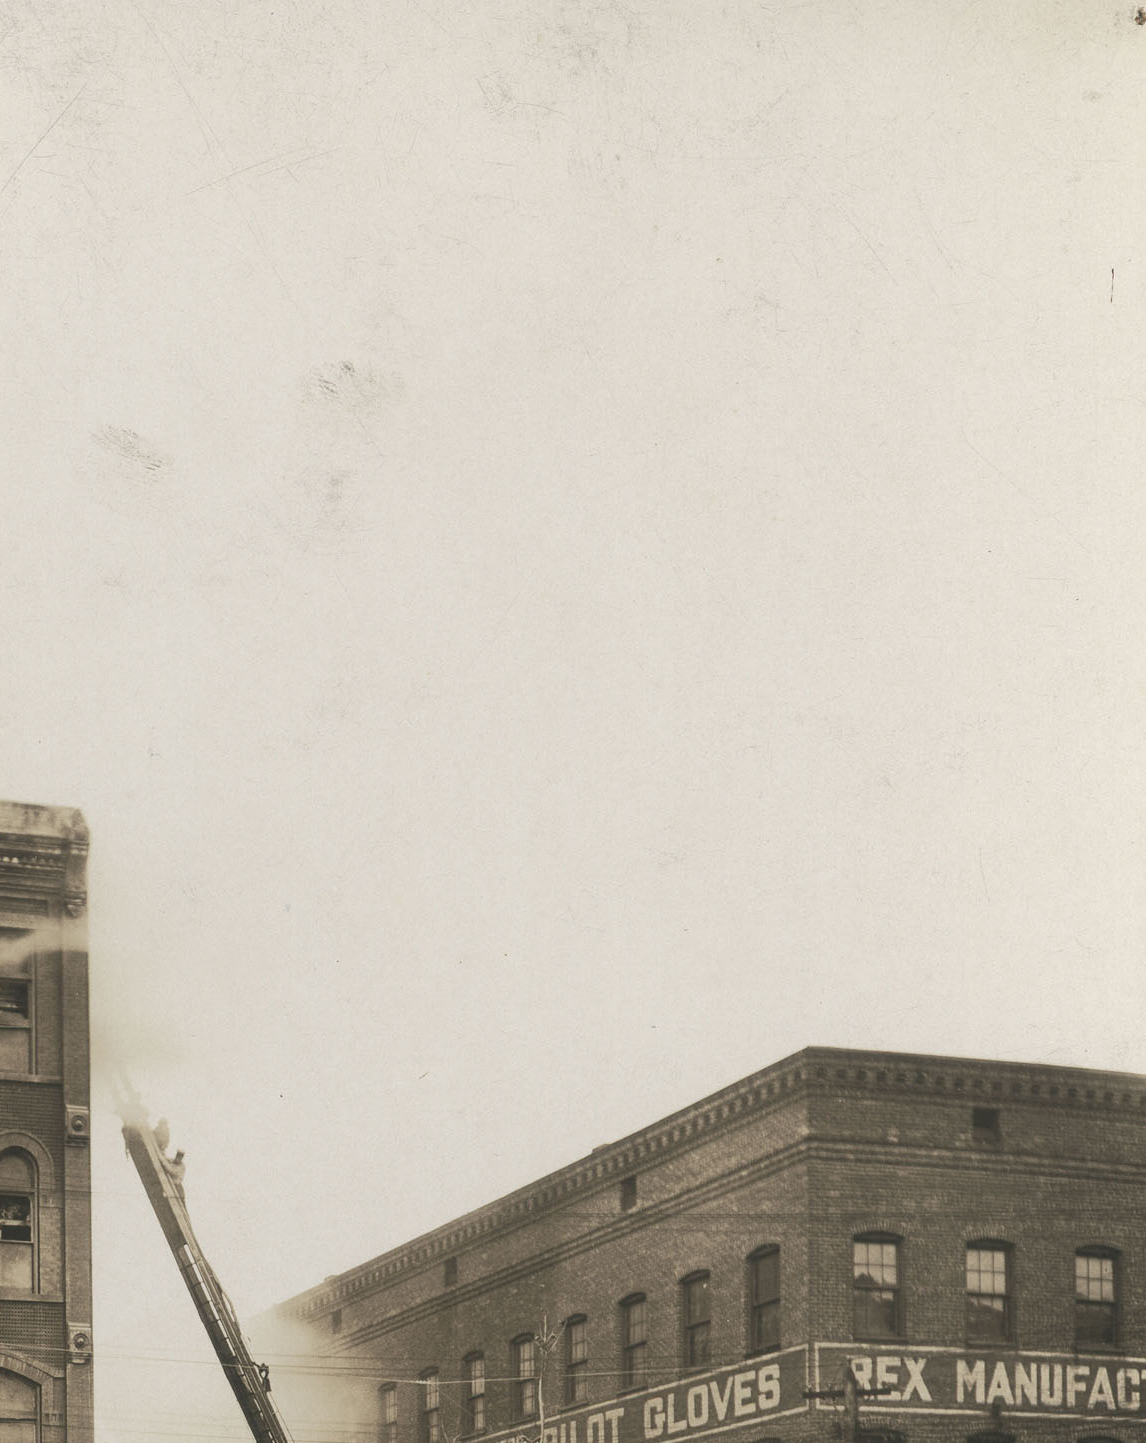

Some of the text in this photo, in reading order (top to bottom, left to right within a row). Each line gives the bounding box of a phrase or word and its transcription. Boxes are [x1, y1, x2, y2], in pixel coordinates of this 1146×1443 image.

[644, 1364, 781, 1440] GLOVES
[848, 1356, 1146, 1412] REX MANUFAC
